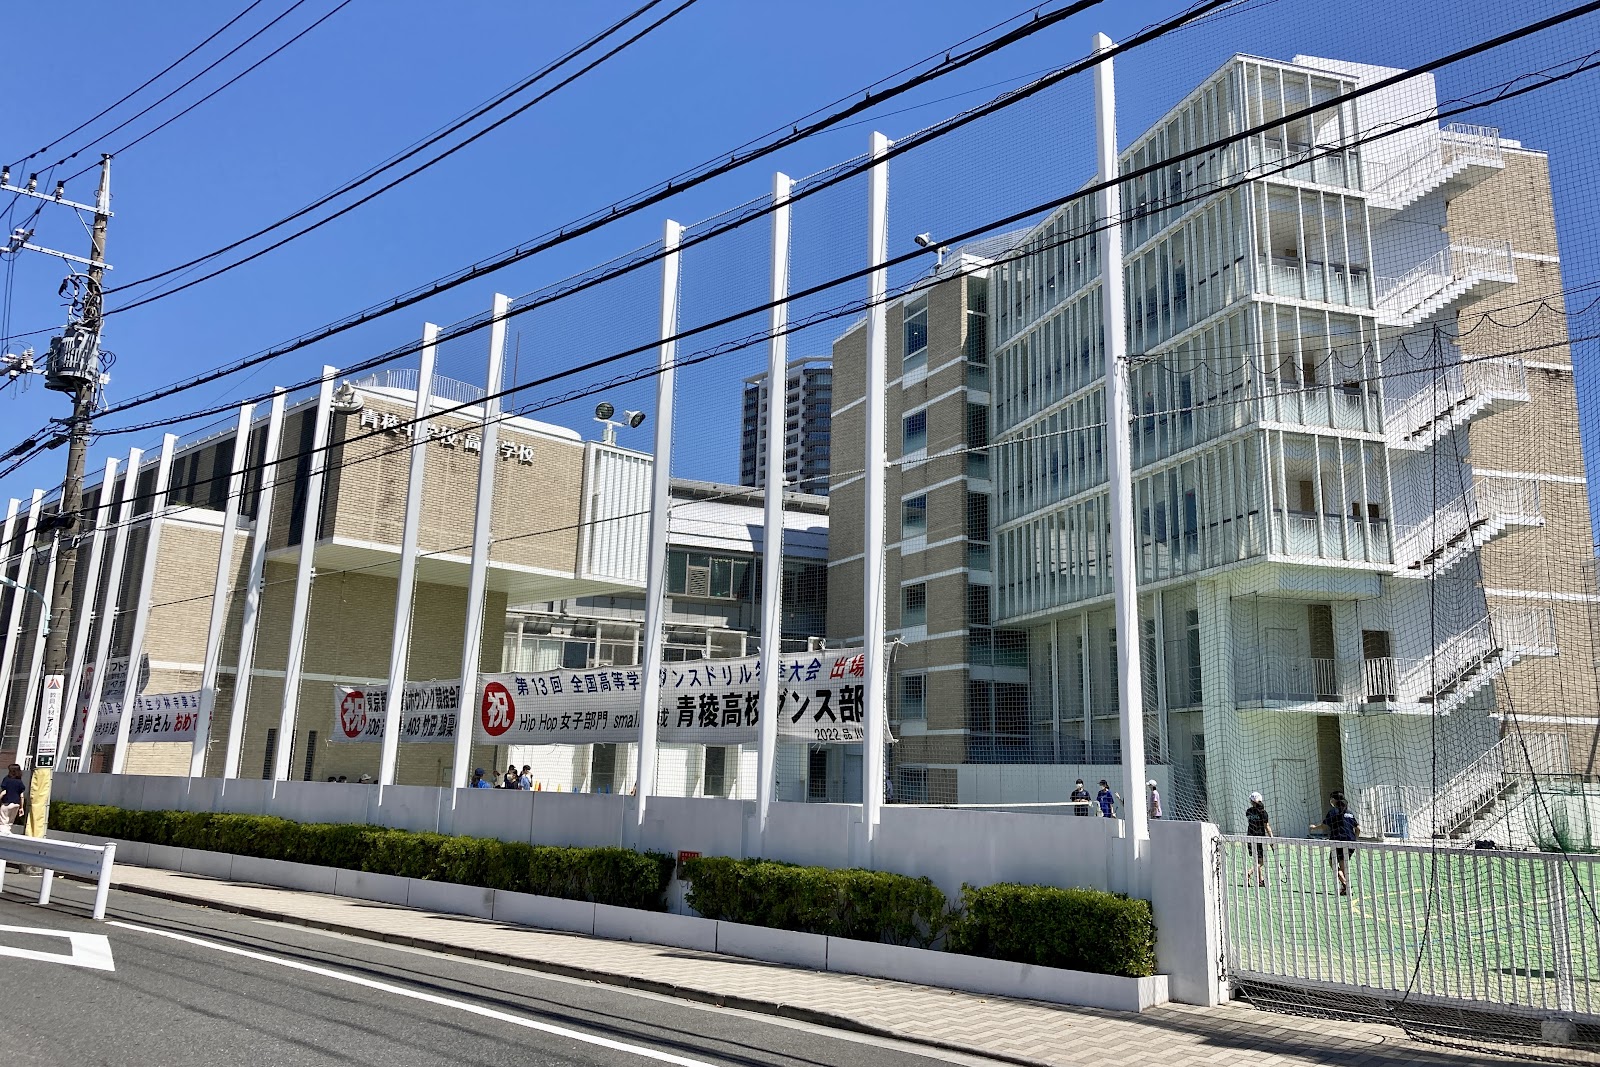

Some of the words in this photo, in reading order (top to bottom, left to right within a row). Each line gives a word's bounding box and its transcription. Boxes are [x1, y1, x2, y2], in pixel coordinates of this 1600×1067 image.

[360, 407, 535, 464] 青稜中学校・高学校
[515, 675, 563, 696] 第13回
[829, 653, 865, 680] 出場
[343, 697, 365, 732] 祝
[487, 691, 511, 728] 祝
[518, 713, 536, 733] Hip
[538, 713, 558, 733] Hop
[560, 710, 608, 731] 女子部門
[613, 709, 641, 729] smal
[814, 728, 841, 741] 2022
